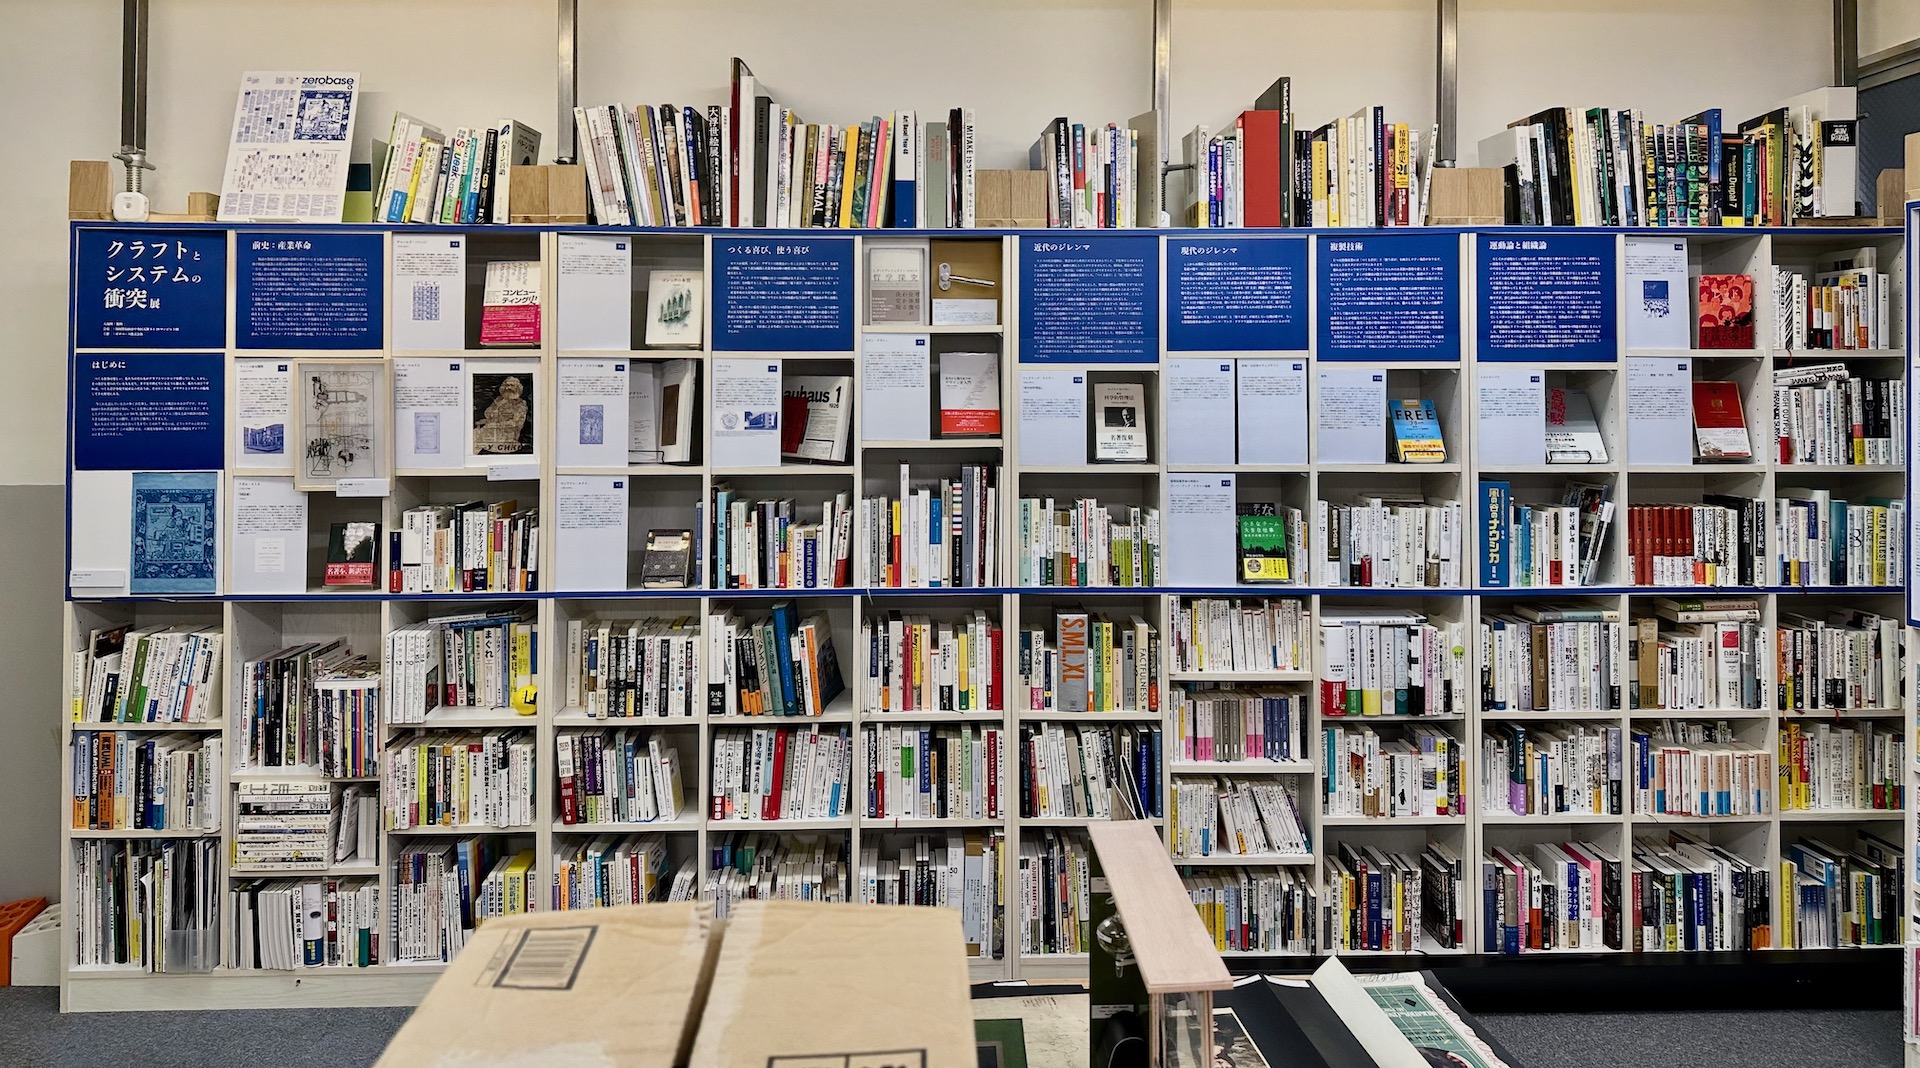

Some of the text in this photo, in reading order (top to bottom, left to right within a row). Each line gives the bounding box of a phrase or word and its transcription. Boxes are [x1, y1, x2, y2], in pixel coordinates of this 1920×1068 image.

[302, 75, 354, 86] zerobase
[709, 107, 720, 157] 大浮世絵展
[643, 138, 654, 167] LOUVRE
[1728, 178, 1737, 202] Drupal
[106, 240, 200, 262] クラフトと
[727, 246, 810, 255] つくる喜び、使う喜び
[1034, 242, 1090, 252] 近代のジレンマ
[1181, 246, 1238, 255] 現代のジレンマ
[1330, 242, 1363, 252] 複製技術
[1489, 241, 1546, 250] 運動論と組織論
[106, 264, 202, 284] システムの
[103, 288, 160, 310] 衝突展
[92, 360, 126, 369] はじめに
[784, 386, 830, 403] auhaus
[1395, 410, 1435, 420] FREE
[484, 630, 493, 658] まぐれ
[1061, 618, 1085, 683] S,M,L,XL
